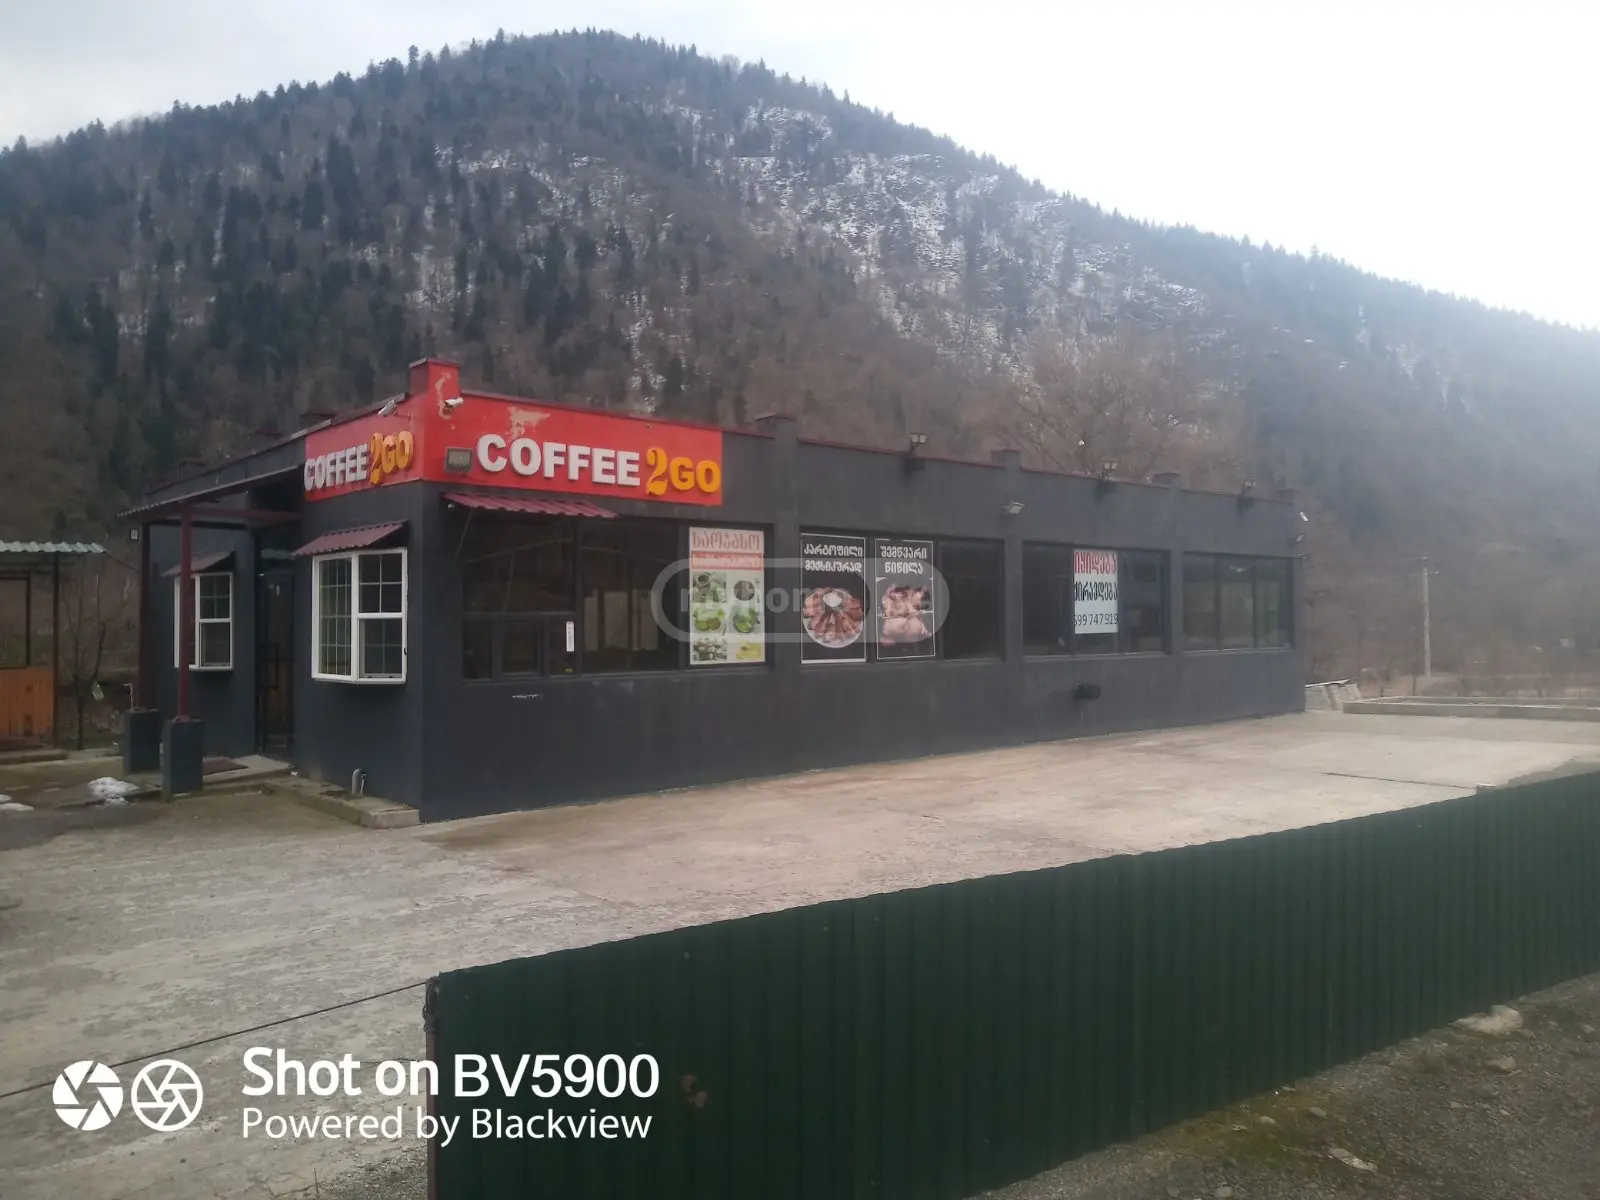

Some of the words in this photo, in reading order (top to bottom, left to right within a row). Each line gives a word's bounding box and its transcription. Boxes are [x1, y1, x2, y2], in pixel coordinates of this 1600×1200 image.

[303, 443, 368, 491] COFFEE
[370, 431, 413, 485] 2GO
[476, 434, 640, 486] COFFEE
[646, 447, 721, 495] 2GO
[804, 544, 863, 557] კარტოფილი
[880, 546, 927, 559] შემწვარი
[884, 561, 923, 574] წიწილა
